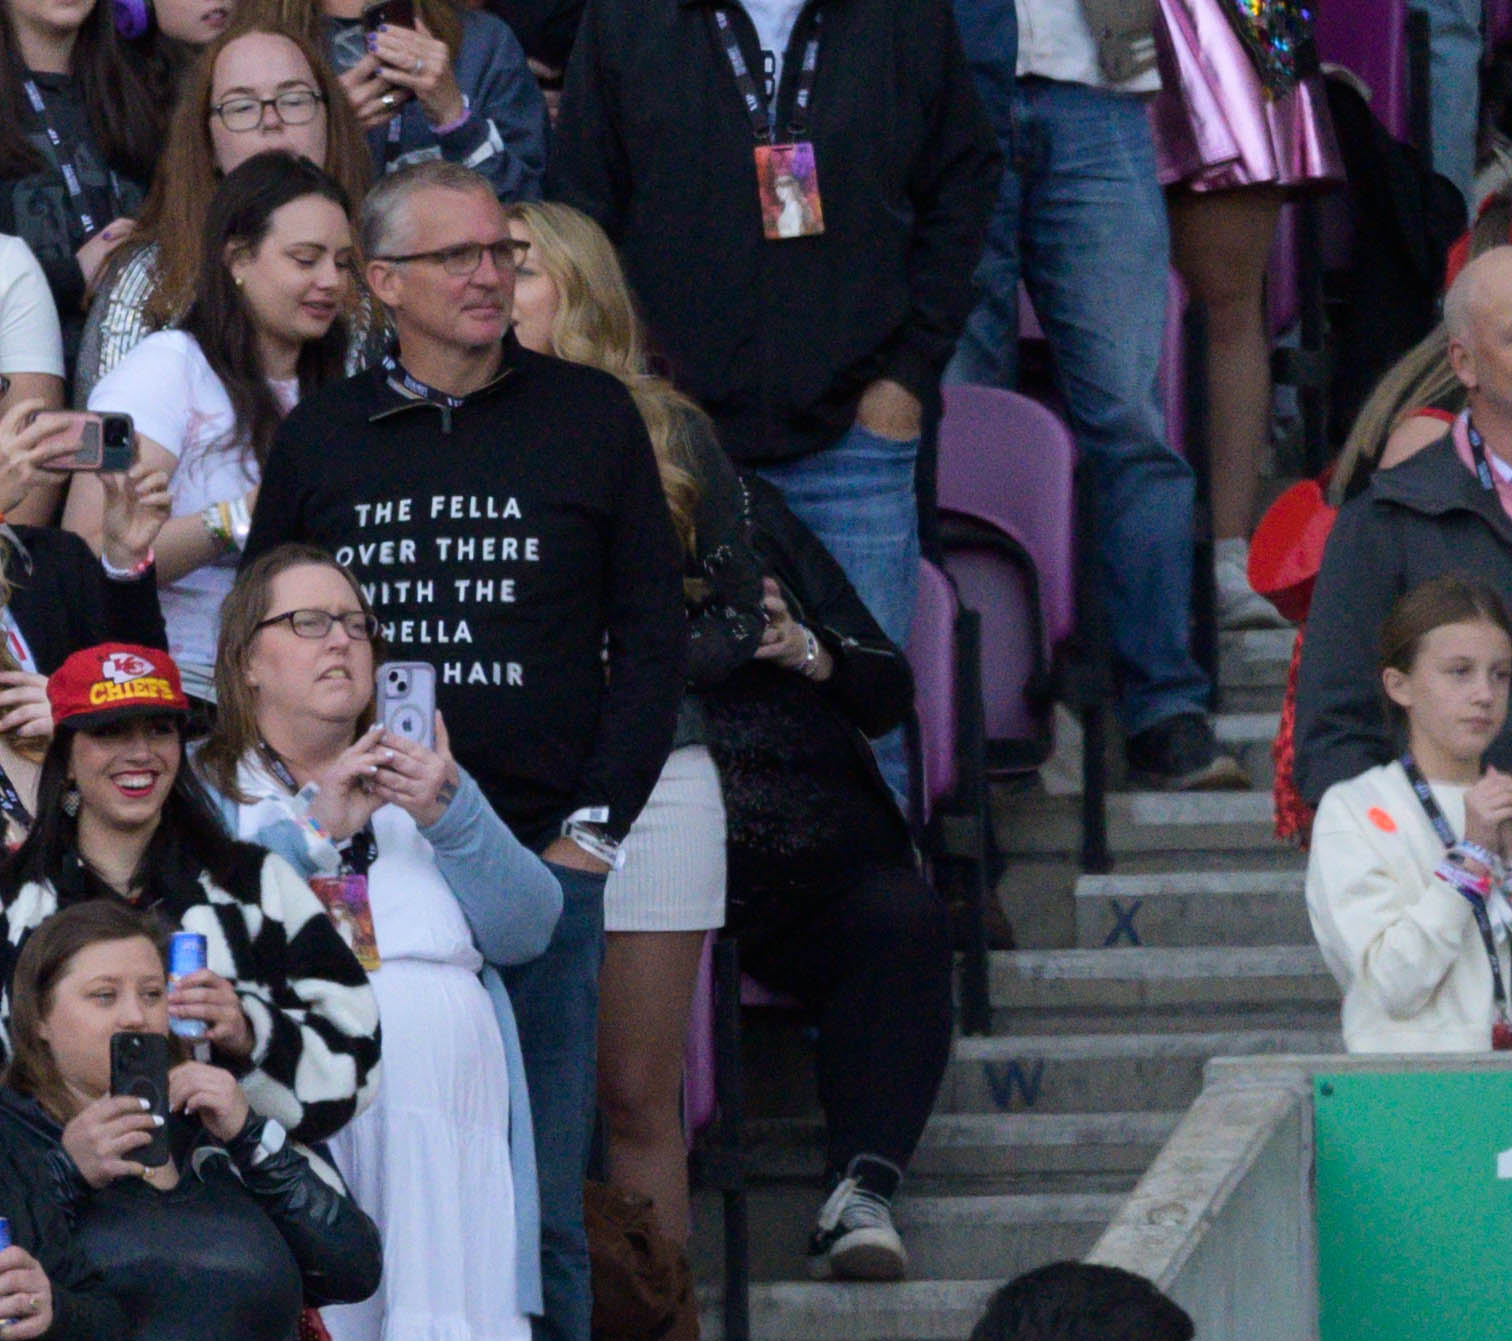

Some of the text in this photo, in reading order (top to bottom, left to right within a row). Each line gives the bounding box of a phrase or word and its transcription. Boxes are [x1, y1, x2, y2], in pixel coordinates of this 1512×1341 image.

[354, 495, 522, 527] THE FELLA
[336, 537, 540, 567] OVER THERE
[361, 579, 517, 606] WITH THE
[443, 661, 524, 686] HAIR
[90, 677, 175, 705] CHIEFS
[1106, 900, 1142, 947] X
[985, 1062, 1044, 1110] W
